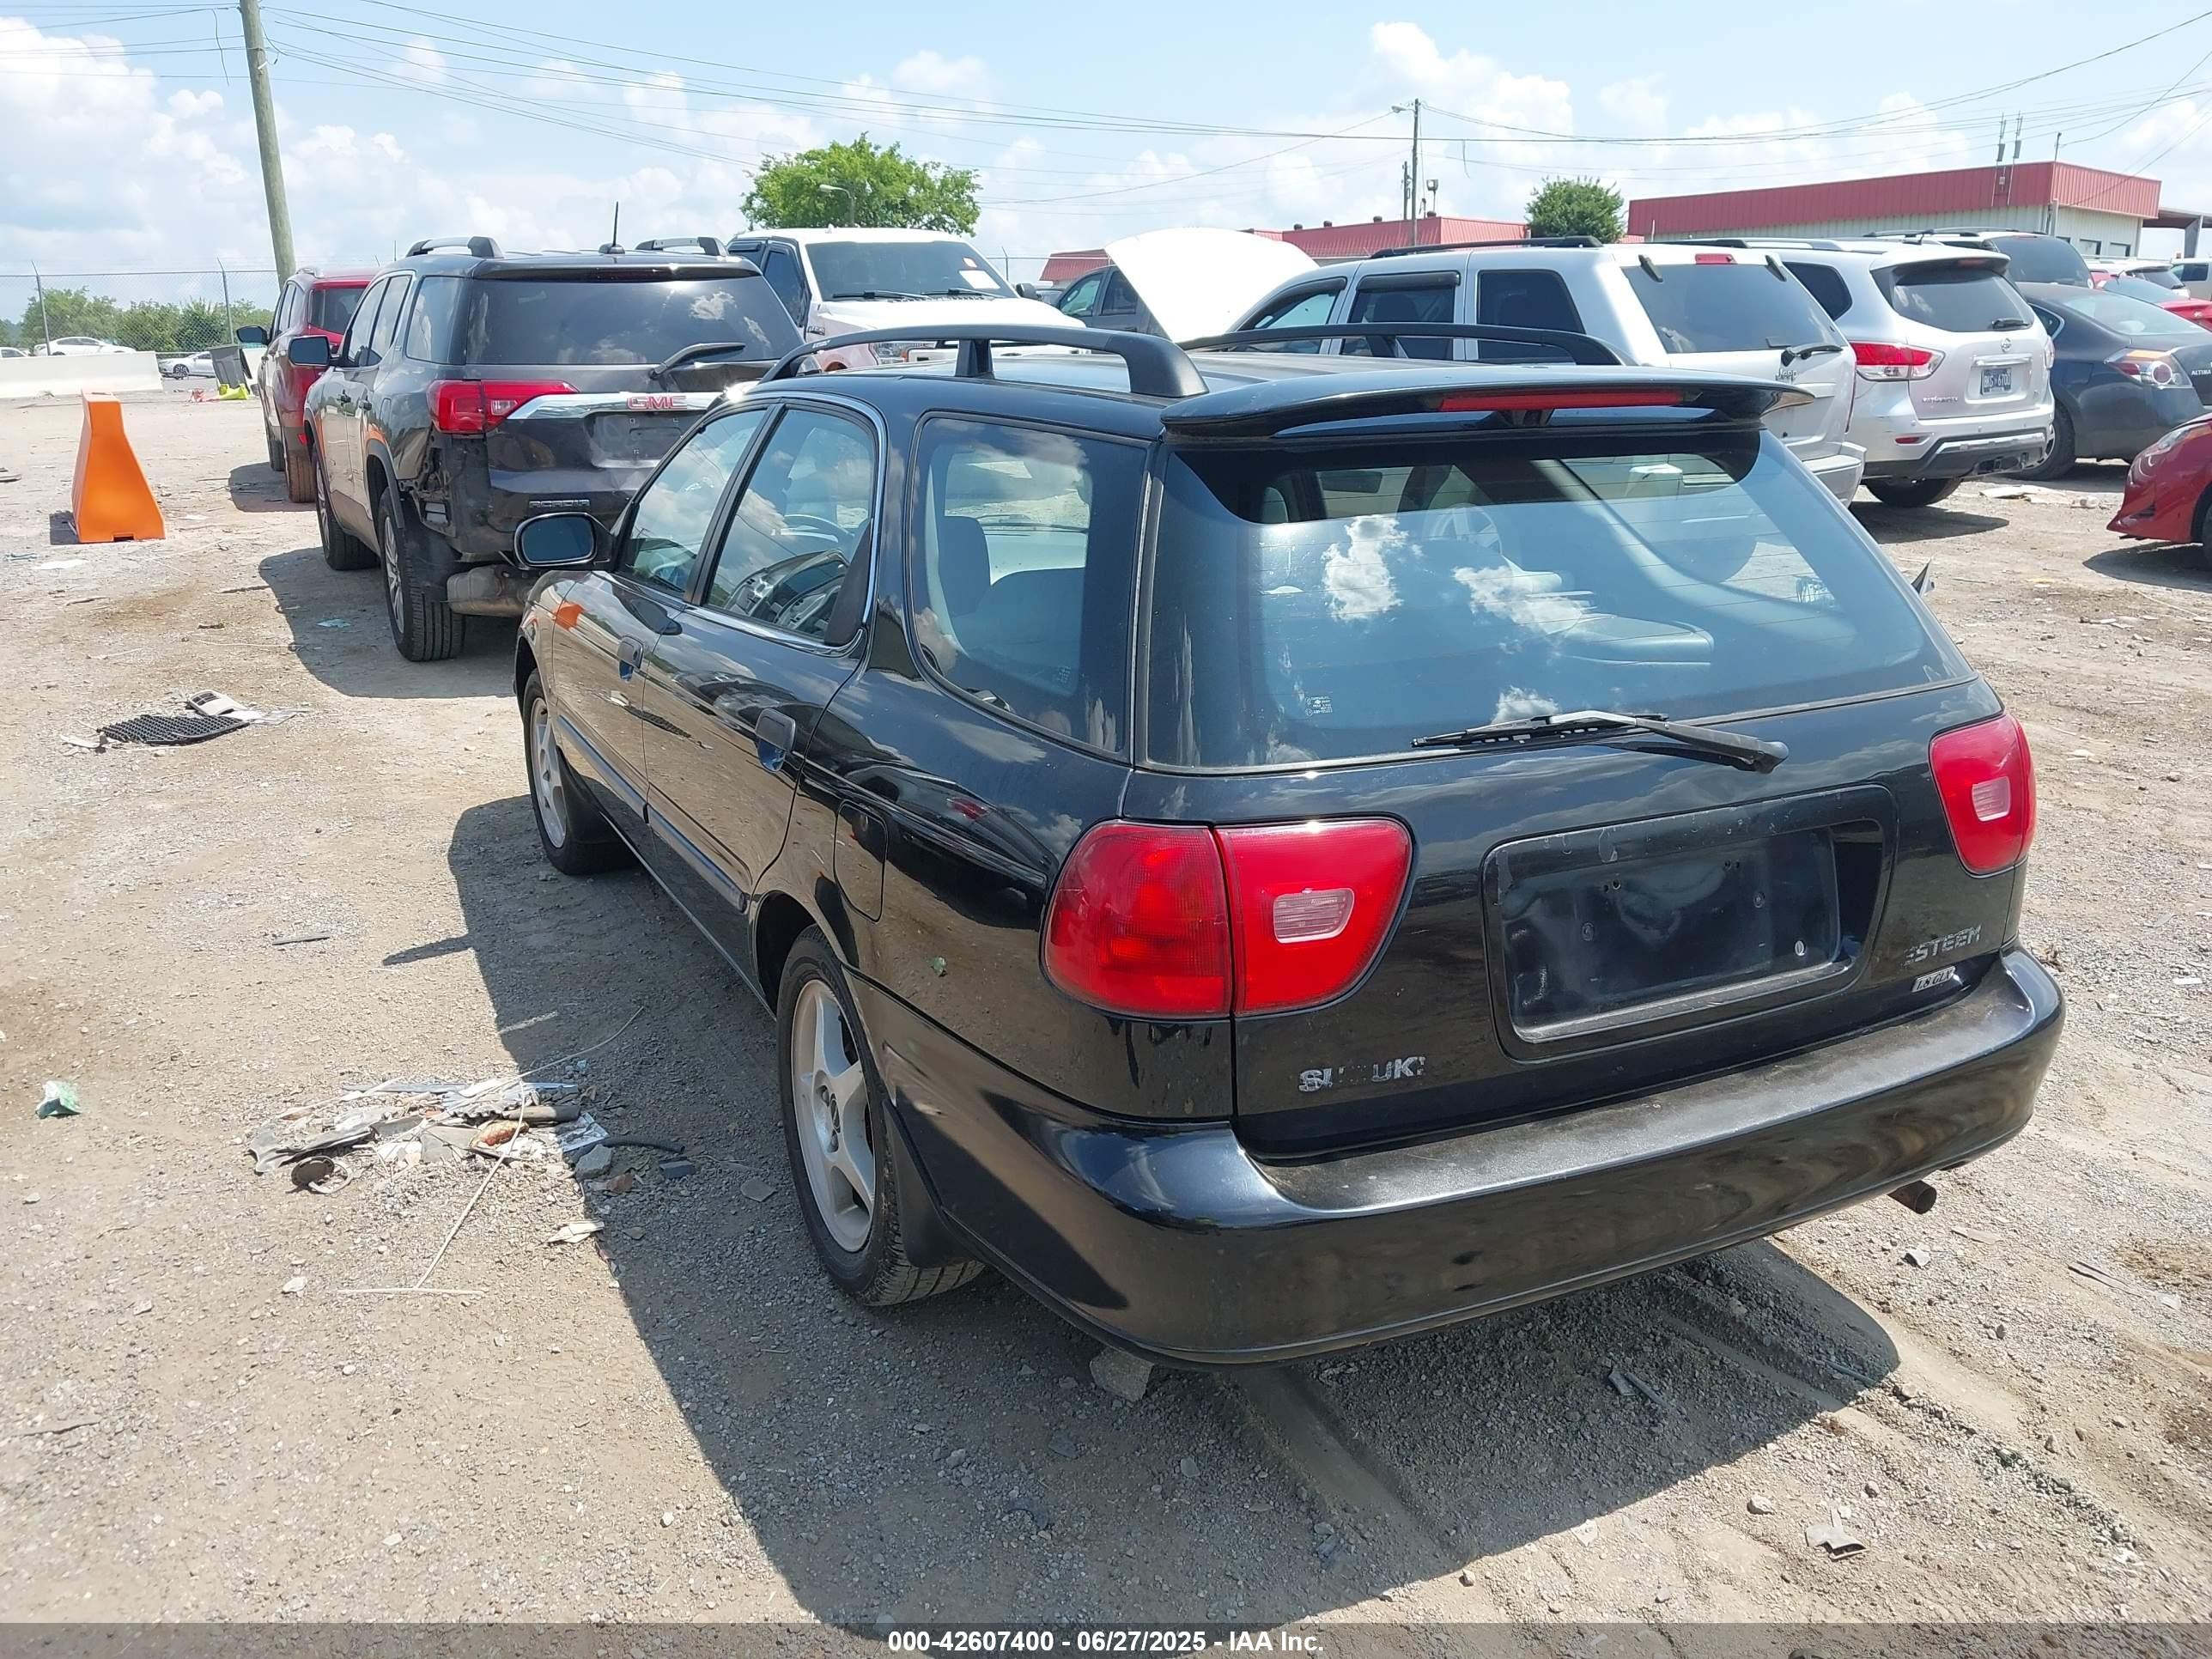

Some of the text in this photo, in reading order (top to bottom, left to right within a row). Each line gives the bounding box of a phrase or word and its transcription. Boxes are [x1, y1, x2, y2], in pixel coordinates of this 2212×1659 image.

[1775, 368, 1797, 382] Jeep
[627, 395, 687, 410] GMC
[529, 499, 591, 508] ACADIA
